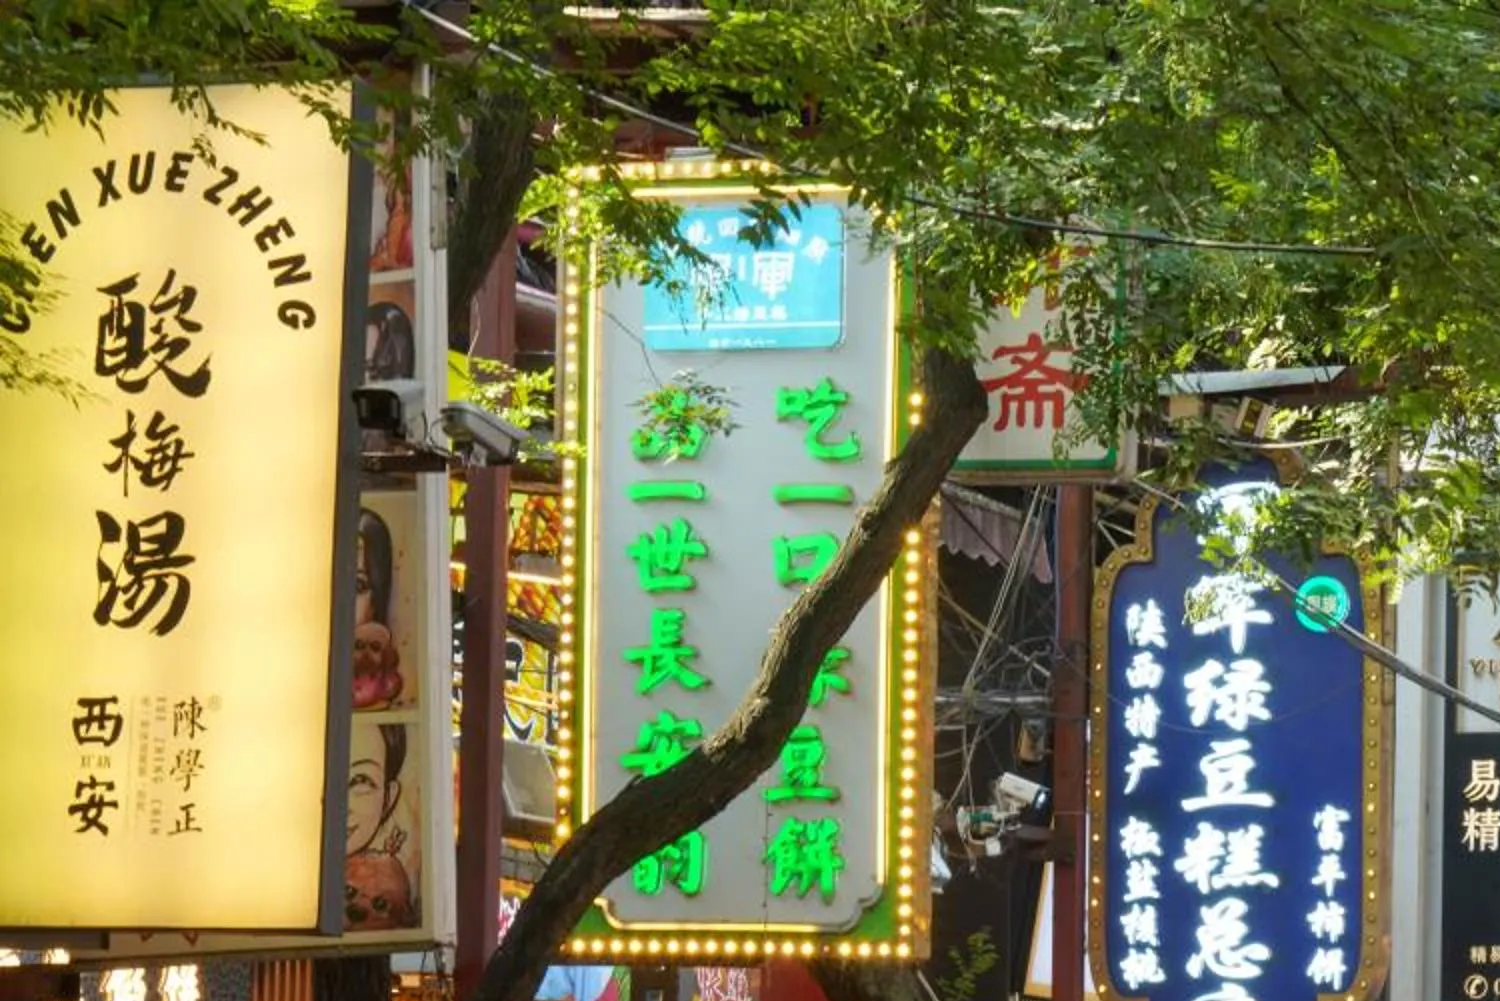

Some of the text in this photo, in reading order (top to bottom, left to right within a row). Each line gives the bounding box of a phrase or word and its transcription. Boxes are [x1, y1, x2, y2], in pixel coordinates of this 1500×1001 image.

[92, 152, 194, 207] XUE
[203, 166, 316, 330] ZHENG
[93, 268, 211, 637] 酸梅湯
[68, 695, 123, 836] 西安
